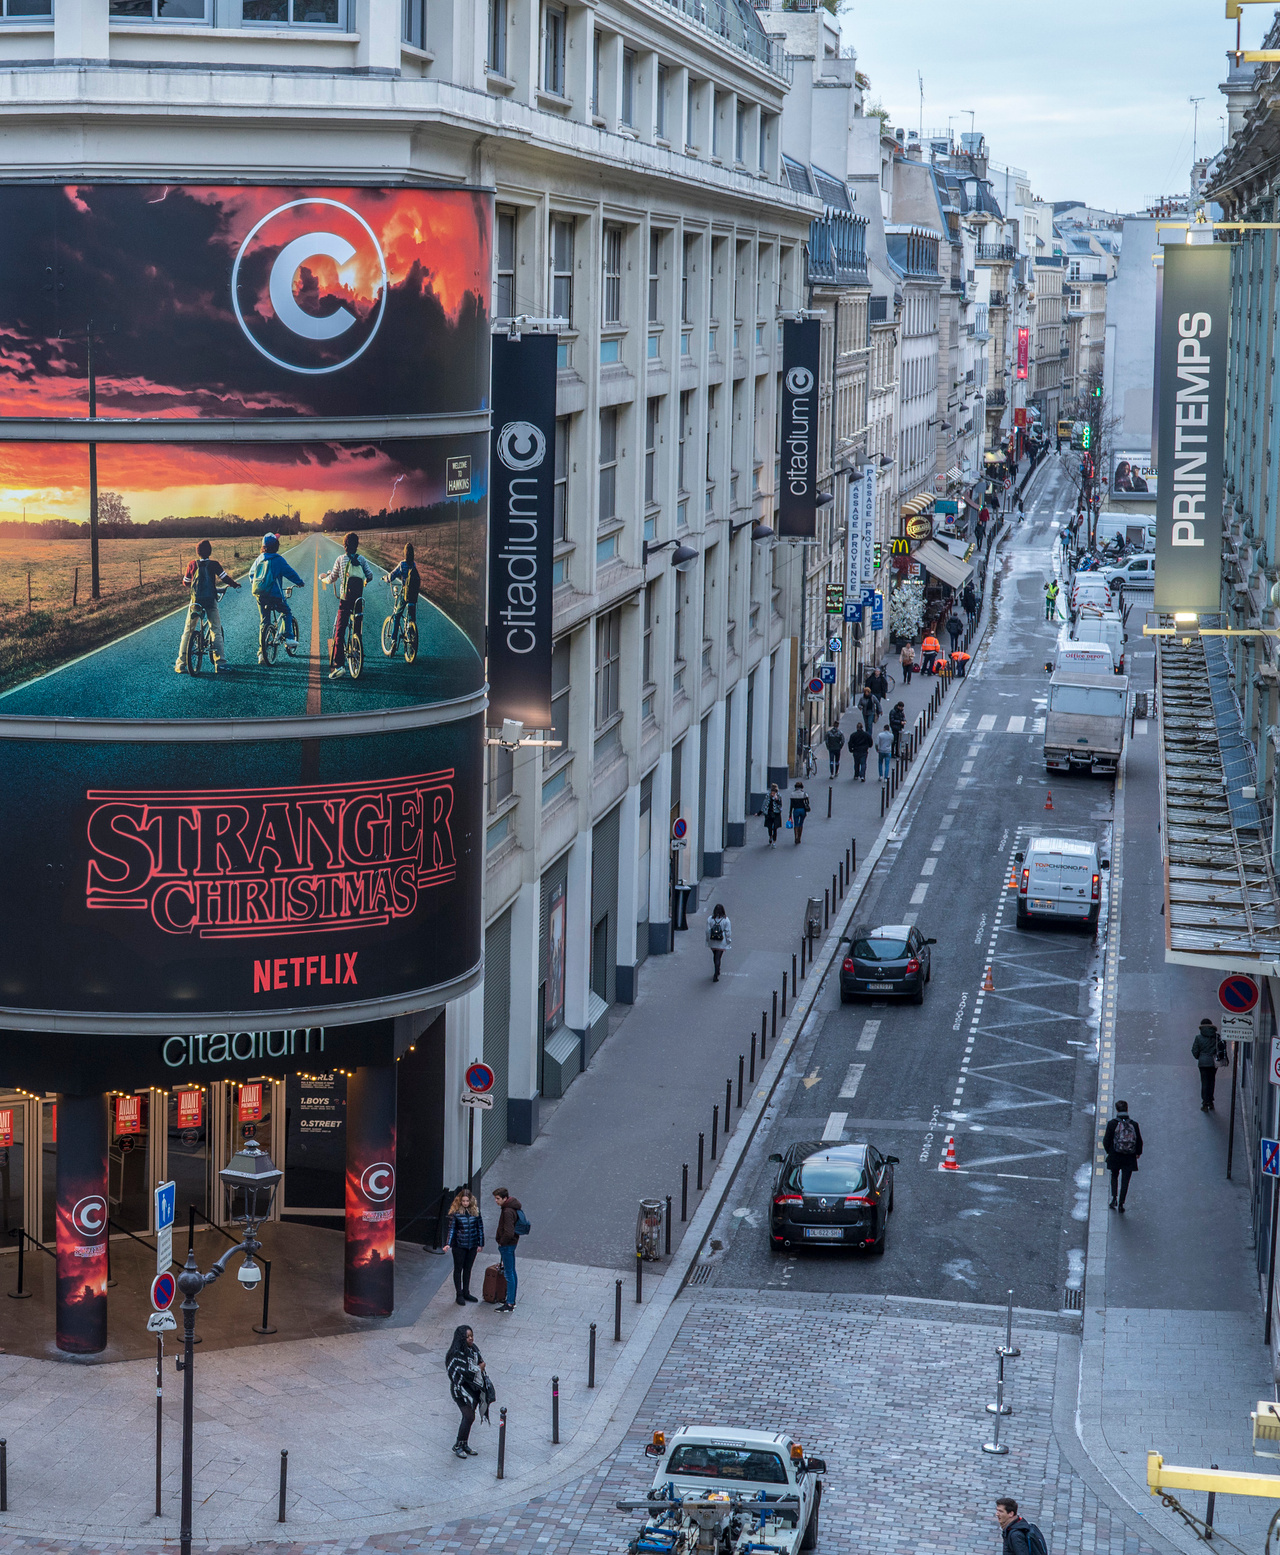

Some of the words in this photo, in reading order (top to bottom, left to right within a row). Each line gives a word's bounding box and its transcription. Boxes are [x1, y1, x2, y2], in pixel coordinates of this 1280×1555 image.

[1019, 330, 1027, 368] HÔTE
[1172, 311, 1212, 547] PRINTEMPS
[786, 398, 809, 496] citadium
[452, 461, 467, 470] WELCOME
[458, 470, 463, 478] TO
[448, 478, 470, 491] HAWKINS
[852, 480, 860, 528] ASSAGE
[864, 522, 872, 577] PROVENCE
[498, 478, 538, 655] citadium
[850, 533, 858, 592] PROVENCE
[861, 590, 870, 602] P
[875, 597, 881, 610] P
[846, 605, 857, 618] P
[821, 668, 831, 679] P
[87, 784, 456, 895] STRANGER
[151, 864, 418, 934] CHRISTMAS
[253, 951, 358, 993] NETFLIX
[162, 1027, 325, 1067] citadium
[181, 1092, 199, 1110] AVANT
[241, 1085, 260, 1104] AVANT
[300, 1097, 330, 1105] 1.BOYS
[119, 1098, 138, 1116] AVANT
[300, 1120, 342, 1128] 0.STREET
